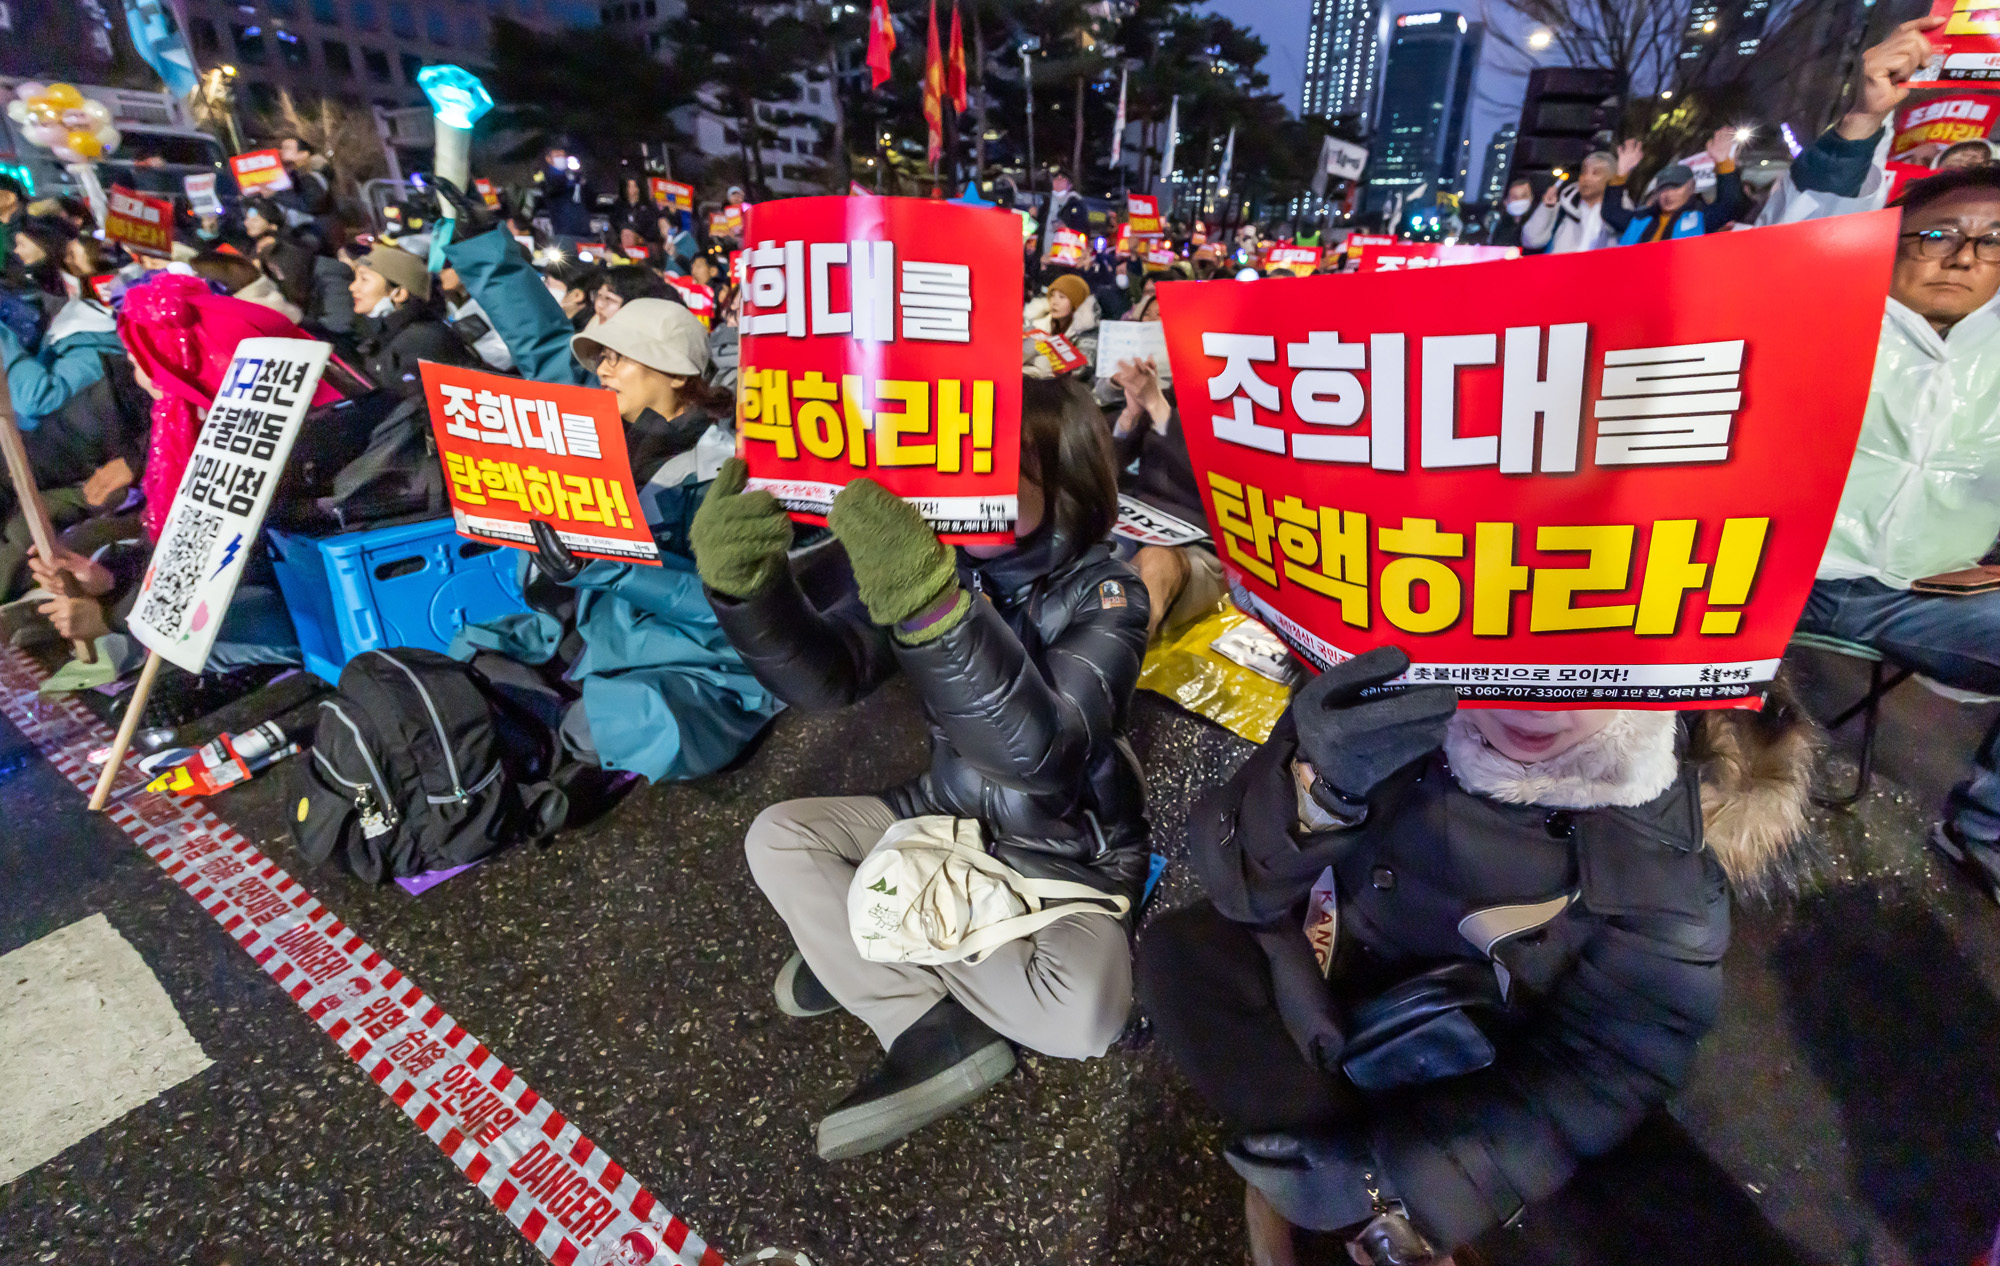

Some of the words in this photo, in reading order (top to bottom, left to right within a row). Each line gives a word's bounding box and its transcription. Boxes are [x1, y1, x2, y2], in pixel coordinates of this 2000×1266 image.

[741, 240, 971, 342] 희대를
[439, 383, 602, 459] 조희대를
[738, 366, 994, 474] 핵하라!
[1201, 322, 1745, 474] 조희대를
[445, 451, 634, 529] 탄핵하라!
[1206, 470, 1770, 635] 탄핵하라!
[1413, 667, 1550, 682] 촛불대행진으로
[1556, 668, 1629, 683] 모이자!
[1475, 687, 1588, 699] 060-707-3300(한
[1591, 688, 1618, 698] 통에
[1623, 688, 1643, 698] 1만
[1646, 688, 1664, 699] 원,
[1668, 687, 1696, 698] 여러
[1699, 686, 1714, 697] 번
[222, 875, 293, 927] 안전제일
[273, 922, 353, 986] DANGER!
[353, 996, 410, 1041] 위험
[385, 1029, 446, 1078] 危險
[425, 1064, 521, 1148] 안전제일
[507, 1140, 621, 1248] DANGER!
